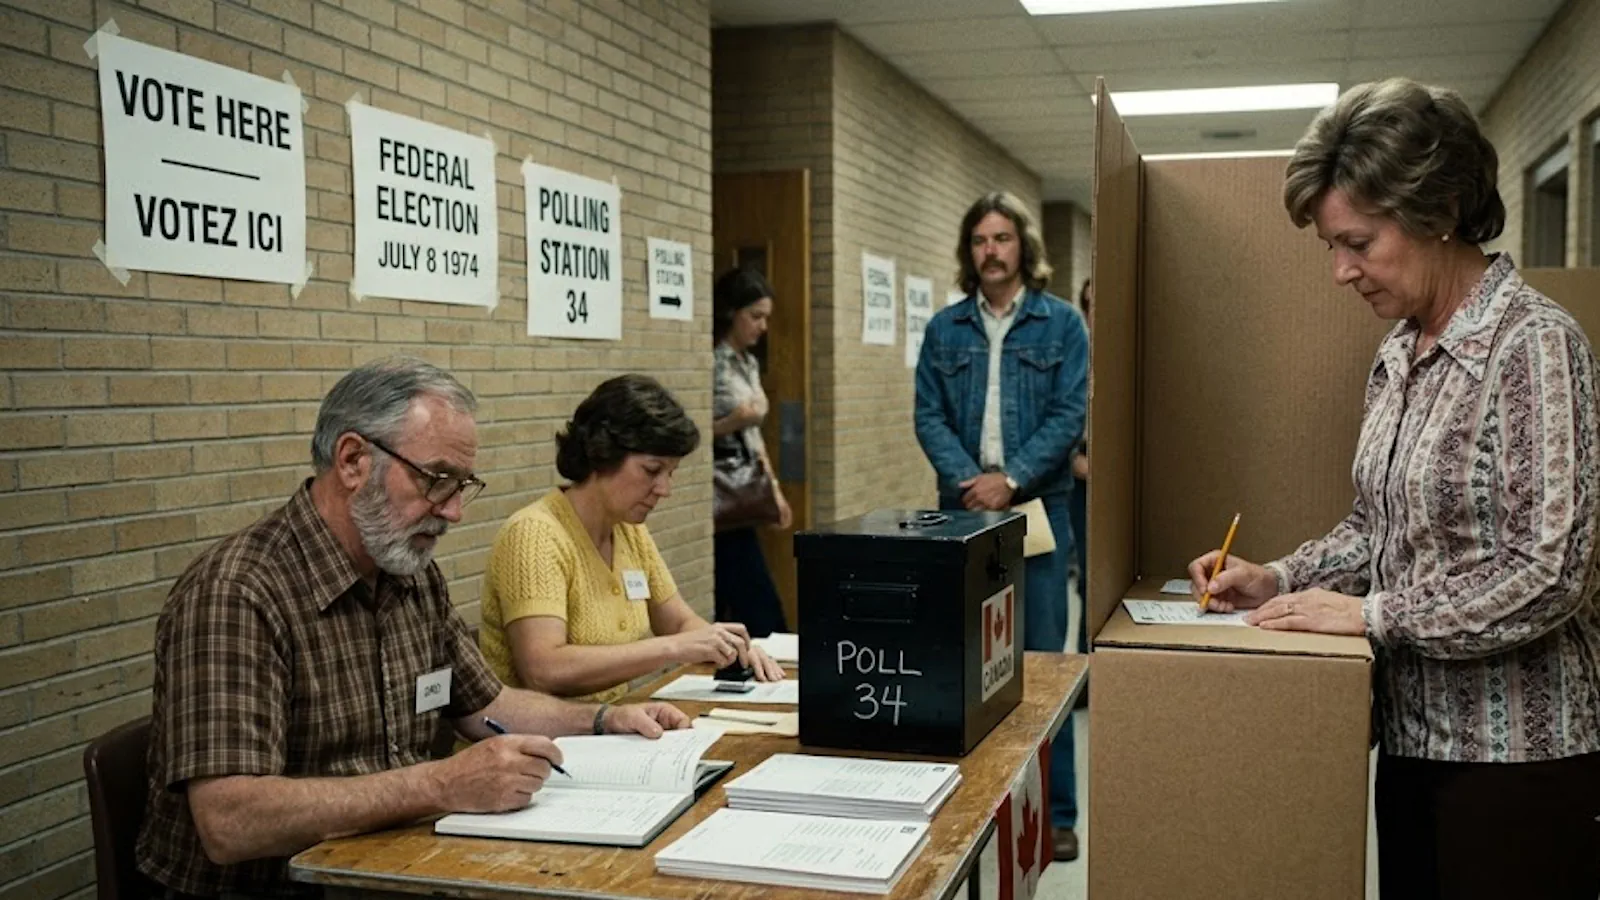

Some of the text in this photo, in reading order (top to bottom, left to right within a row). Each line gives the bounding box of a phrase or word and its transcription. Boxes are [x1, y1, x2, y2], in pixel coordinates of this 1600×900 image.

[115, 69, 291, 151] VOTE HERE
[379, 137, 475, 191] FEDERAL
[133, 193, 283, 253] VOTEZ ICI
[377, 185, 479, 236] ELECTION
[539, 187, 609, 234] POLLING
[378, 241, 479, 278] JULY 8 1974
[540, 238, 609, 281] STATION
[567, 289, 589, 324] 34
[837, 640, 923, 677] POLL
[852, 682, 908, 726] 34
